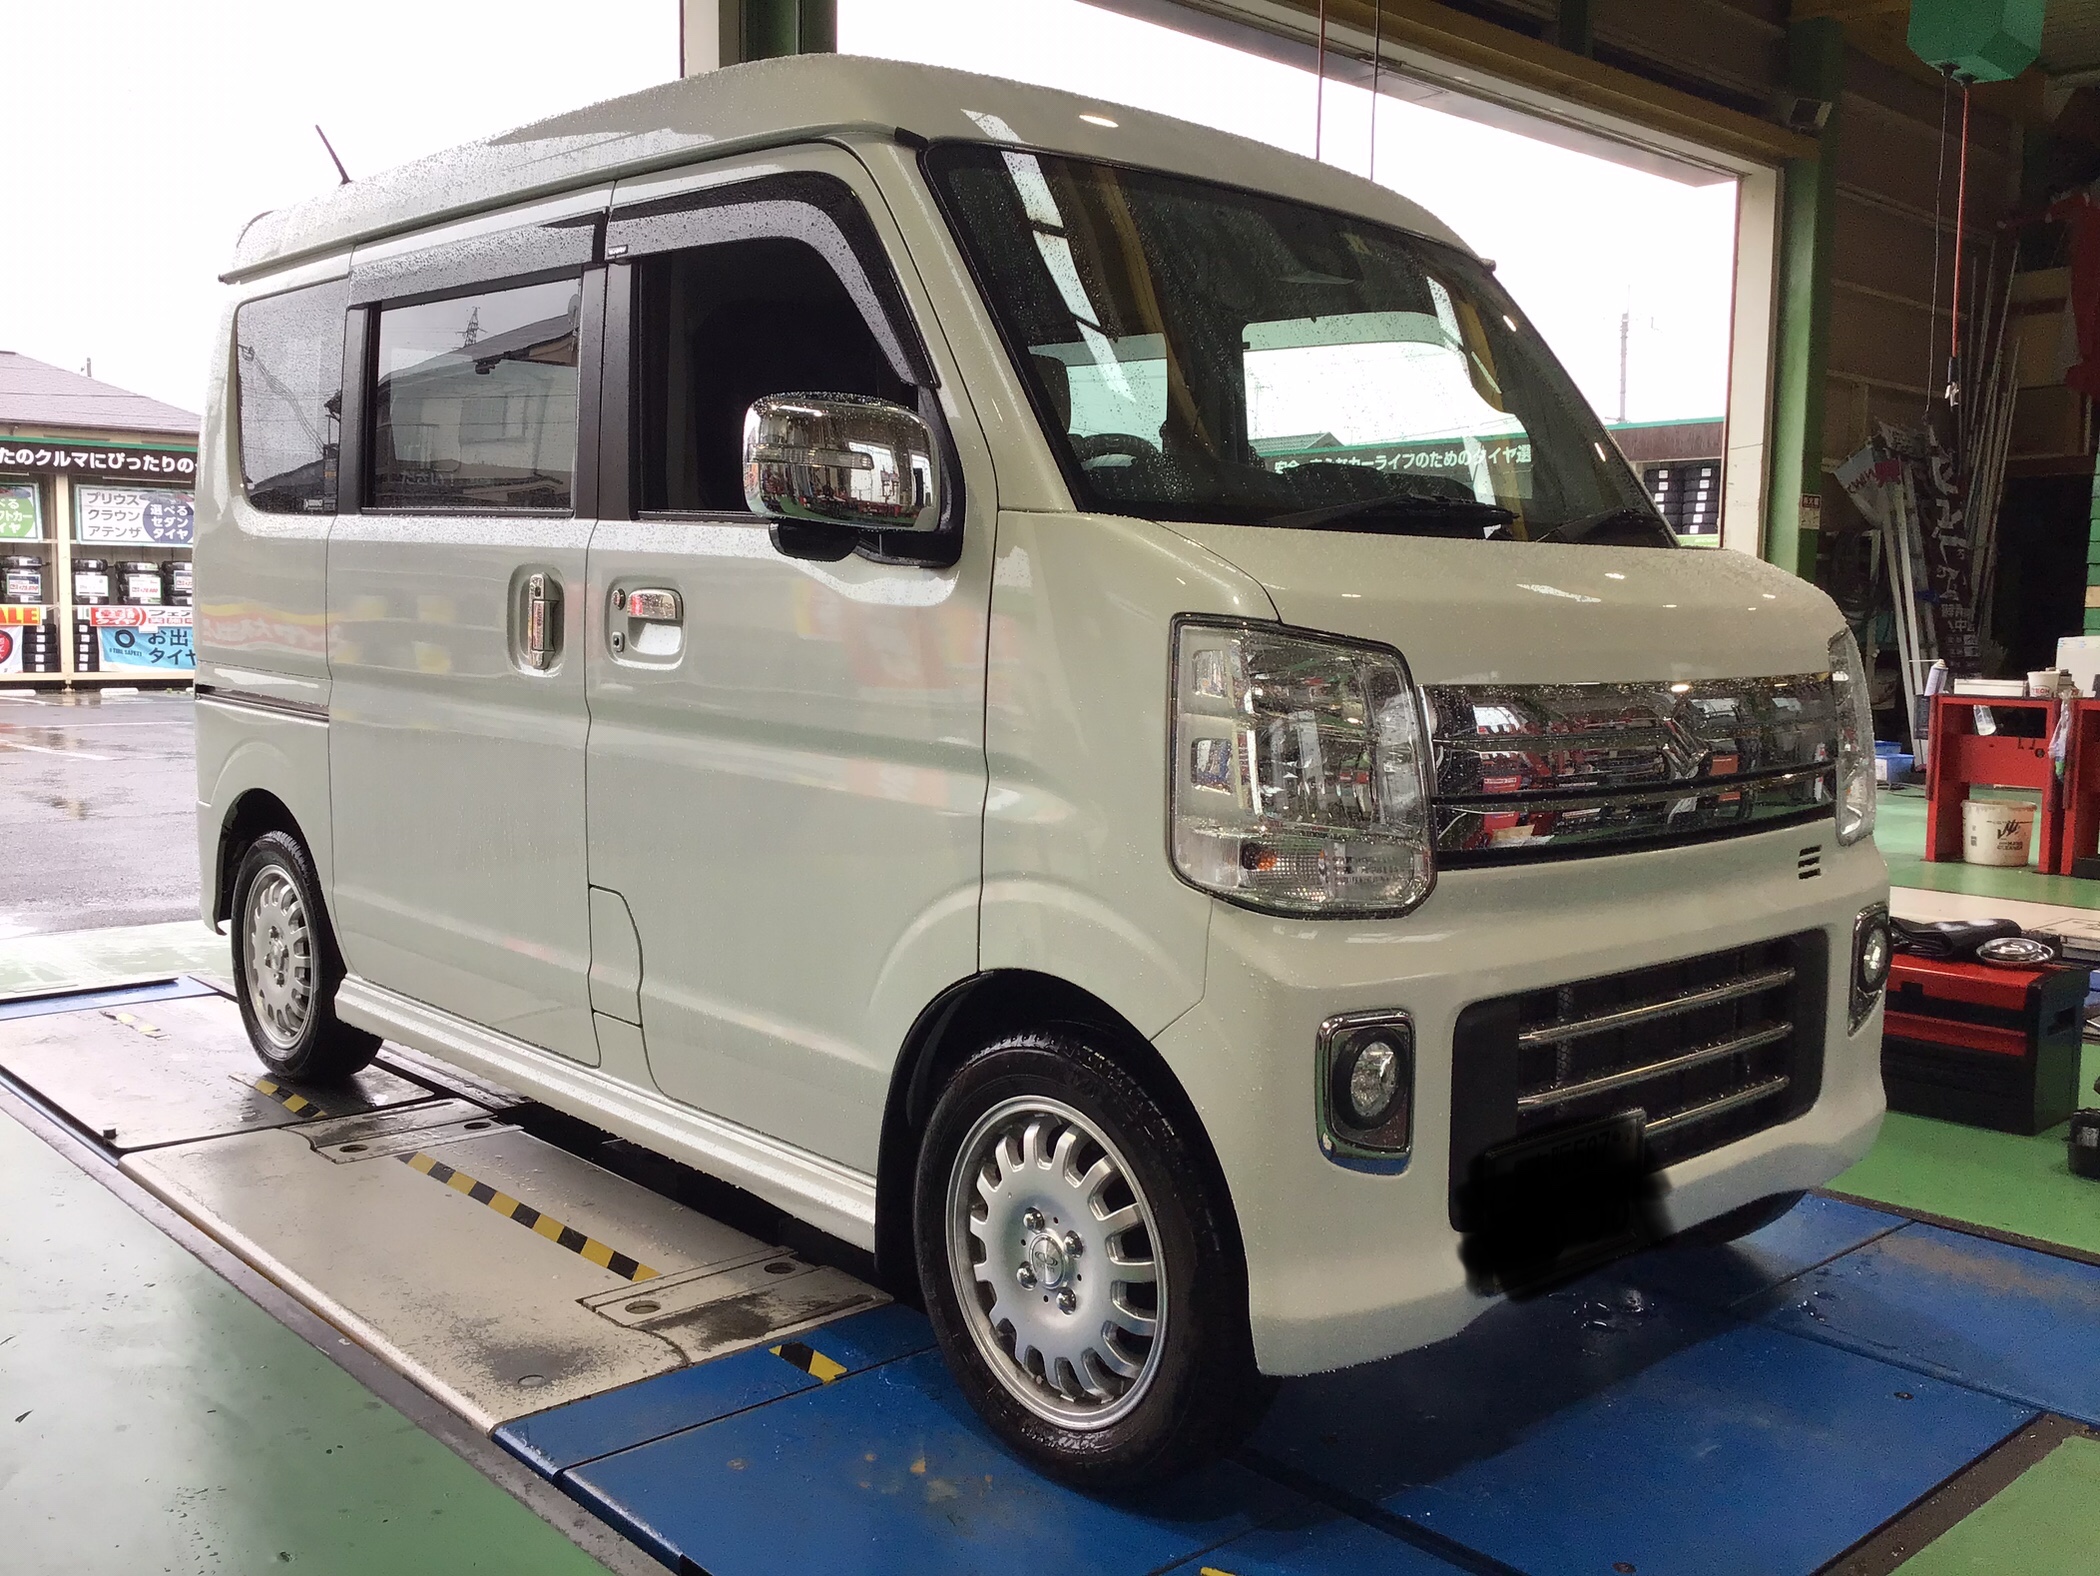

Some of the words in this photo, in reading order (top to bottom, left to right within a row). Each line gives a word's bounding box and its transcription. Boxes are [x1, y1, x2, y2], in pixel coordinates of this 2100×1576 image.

[0, 447, 197, 473] たのクルマにぴったりの
[87, 492, 139, 505] プリウス
[88, 509, 140, 521] クラウン
[150, 504, 188, 516] 選べる
[151, 517, 189, 528] セダン
[88, 525, 142, 538] アテンザ
[153, 528, 189, 540] タイヤ
